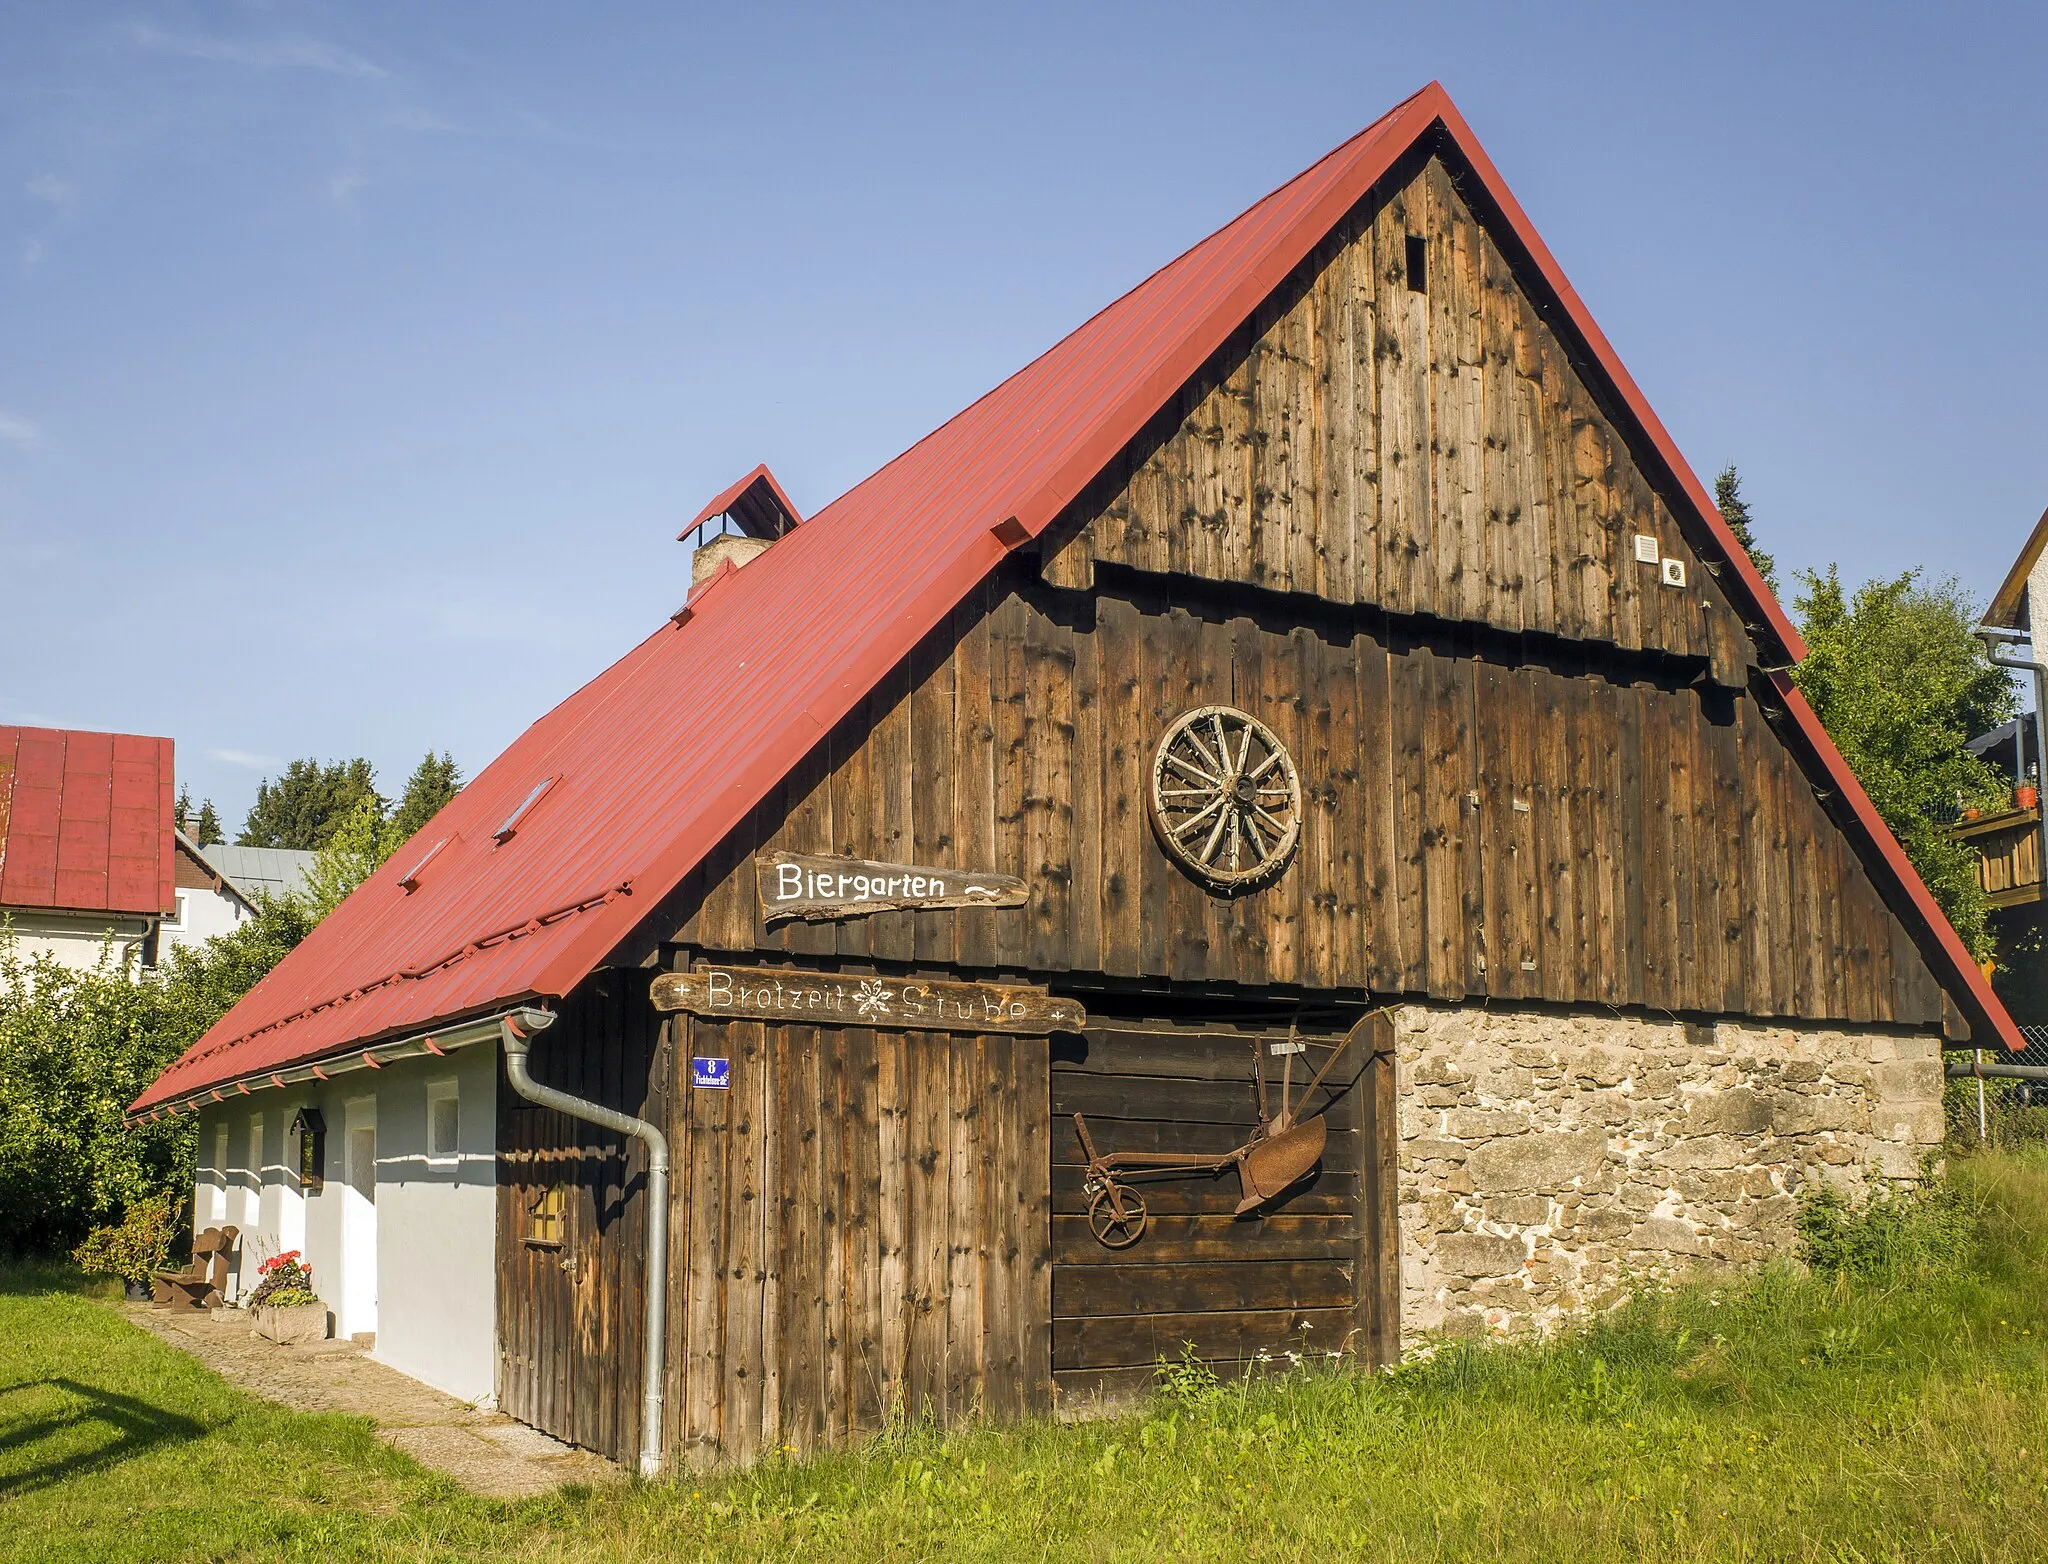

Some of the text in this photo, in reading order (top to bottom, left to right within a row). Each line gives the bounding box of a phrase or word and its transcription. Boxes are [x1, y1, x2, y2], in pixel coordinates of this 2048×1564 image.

[776, 864, 945, 901] Biergarten
[708, 971, 1027, 1022] Brotzeit Stube
[707, 1060, 716, 1074] 8
